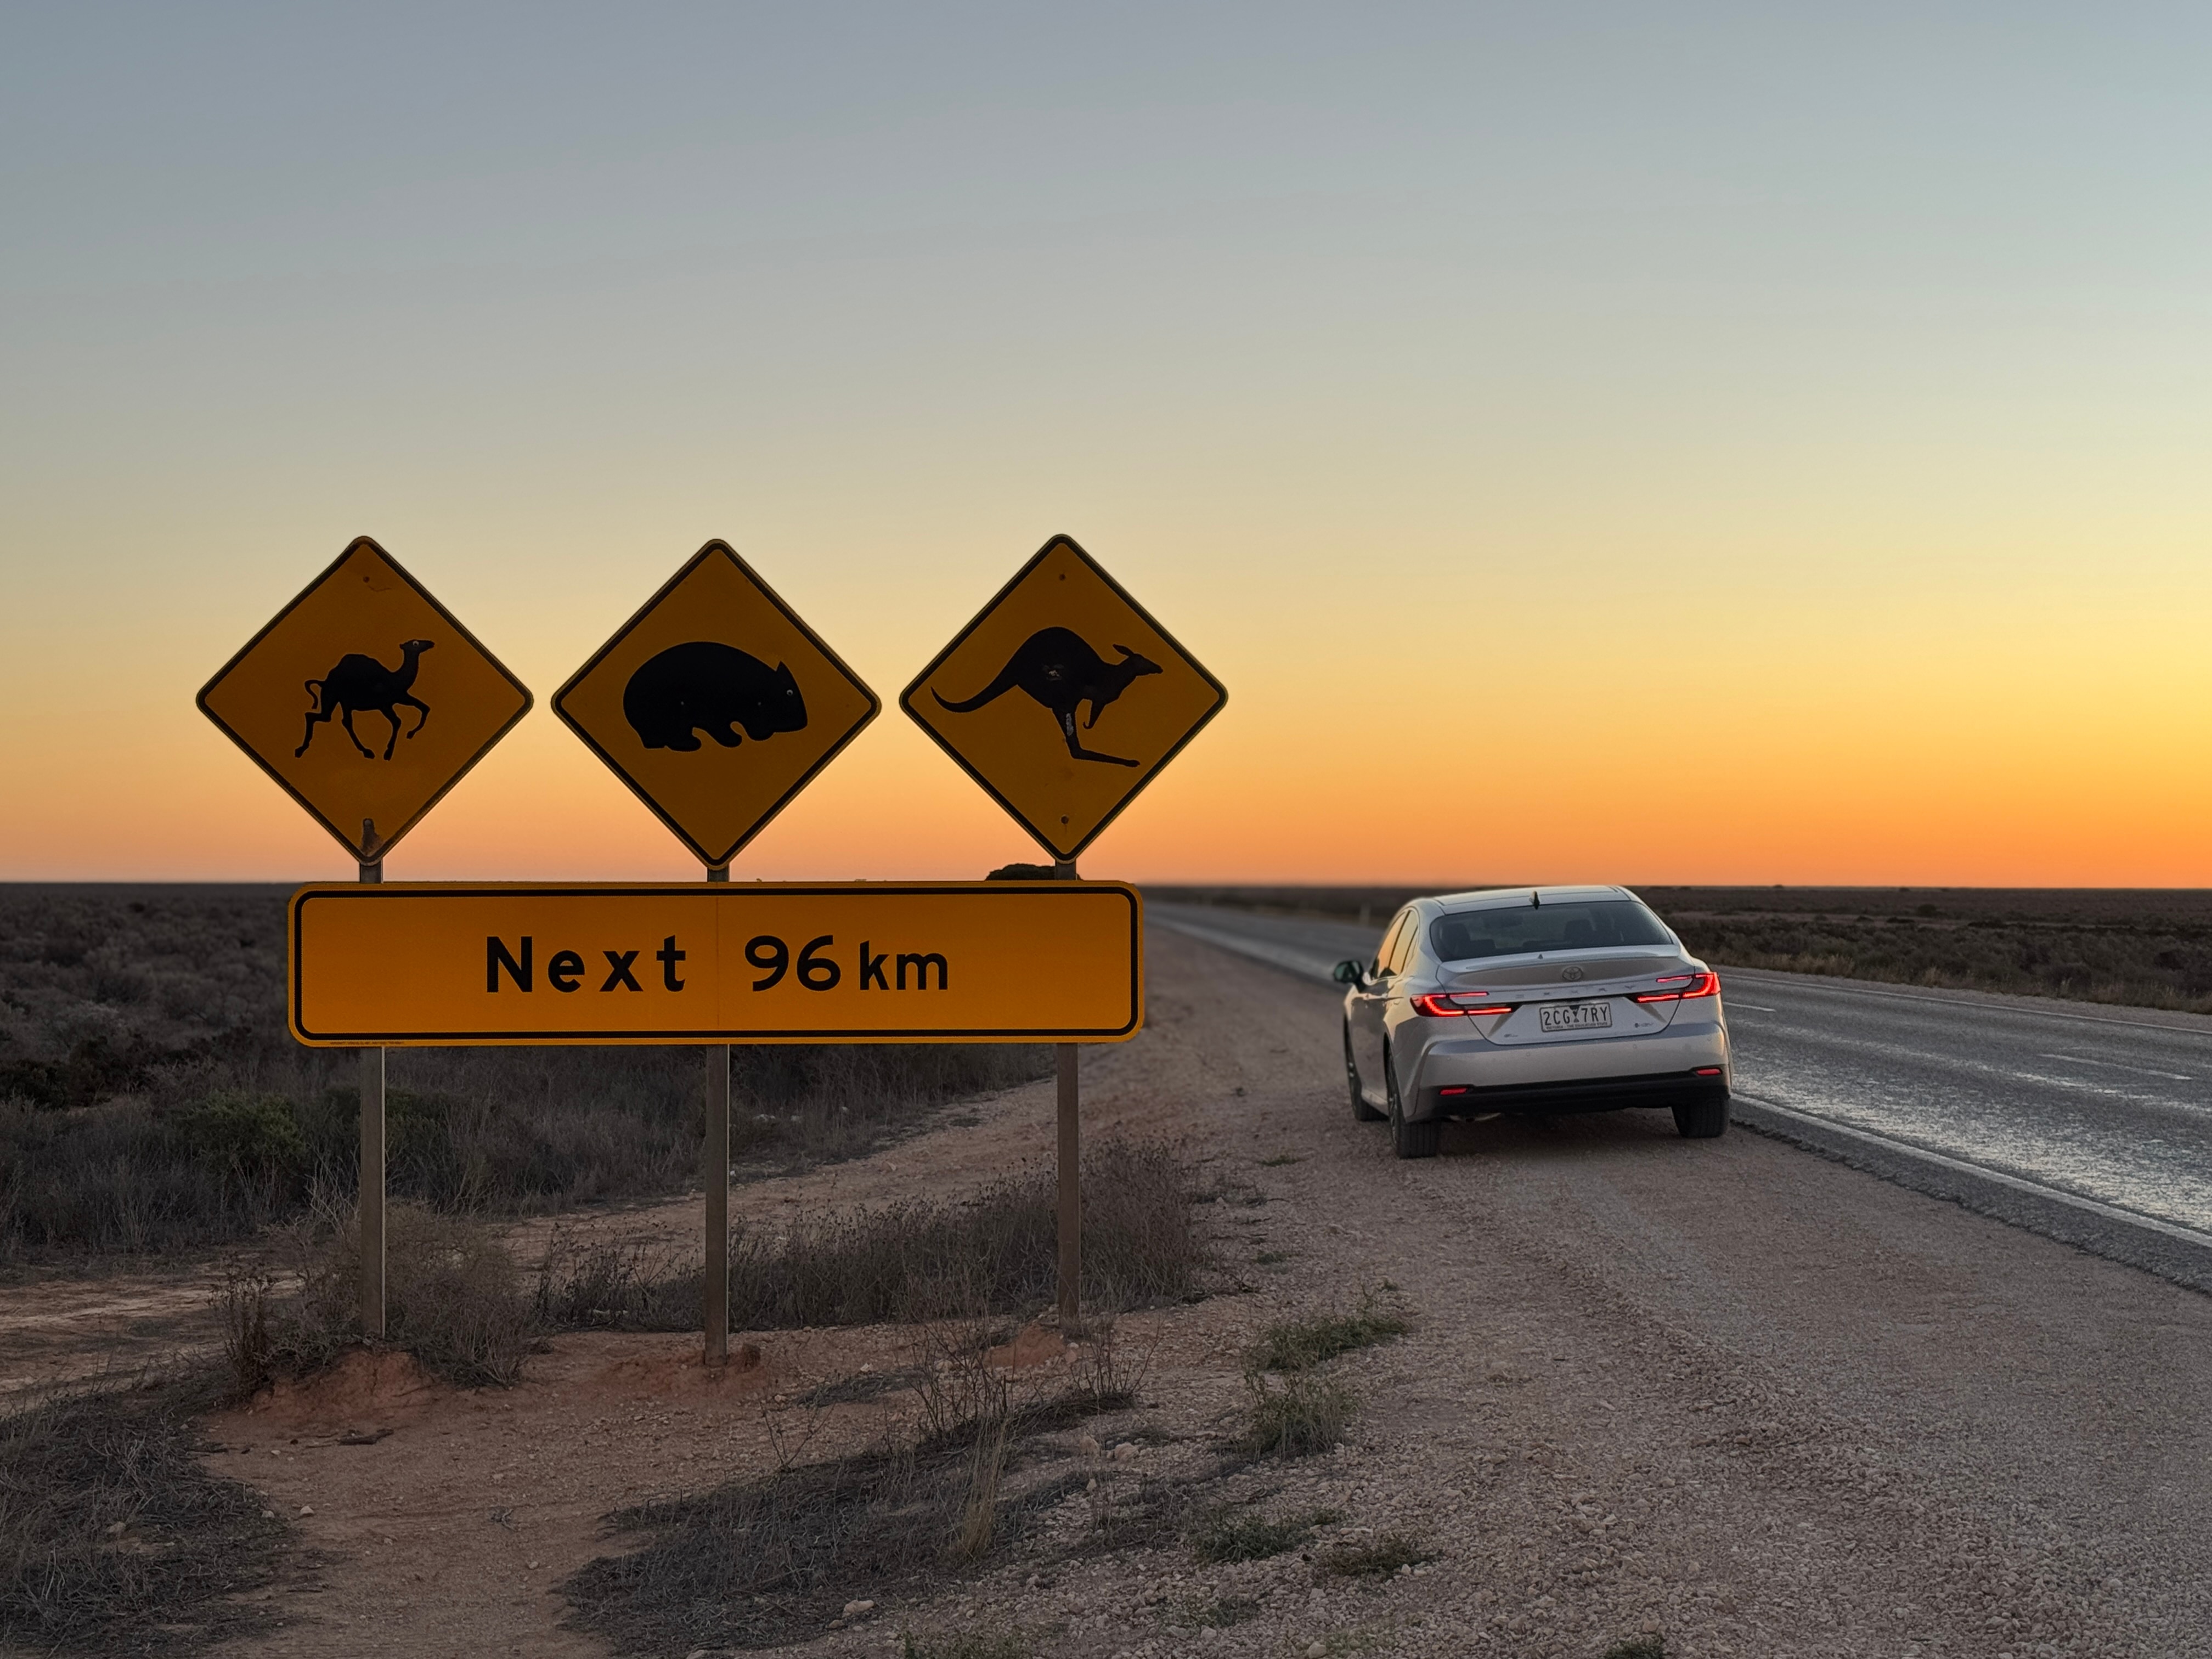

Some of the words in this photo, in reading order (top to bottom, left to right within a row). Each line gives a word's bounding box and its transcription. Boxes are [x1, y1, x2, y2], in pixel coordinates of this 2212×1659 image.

[486, 934, 686, 993] Next
[744, 934, 841, 992] 96
[859, 940, 948, 991] km
